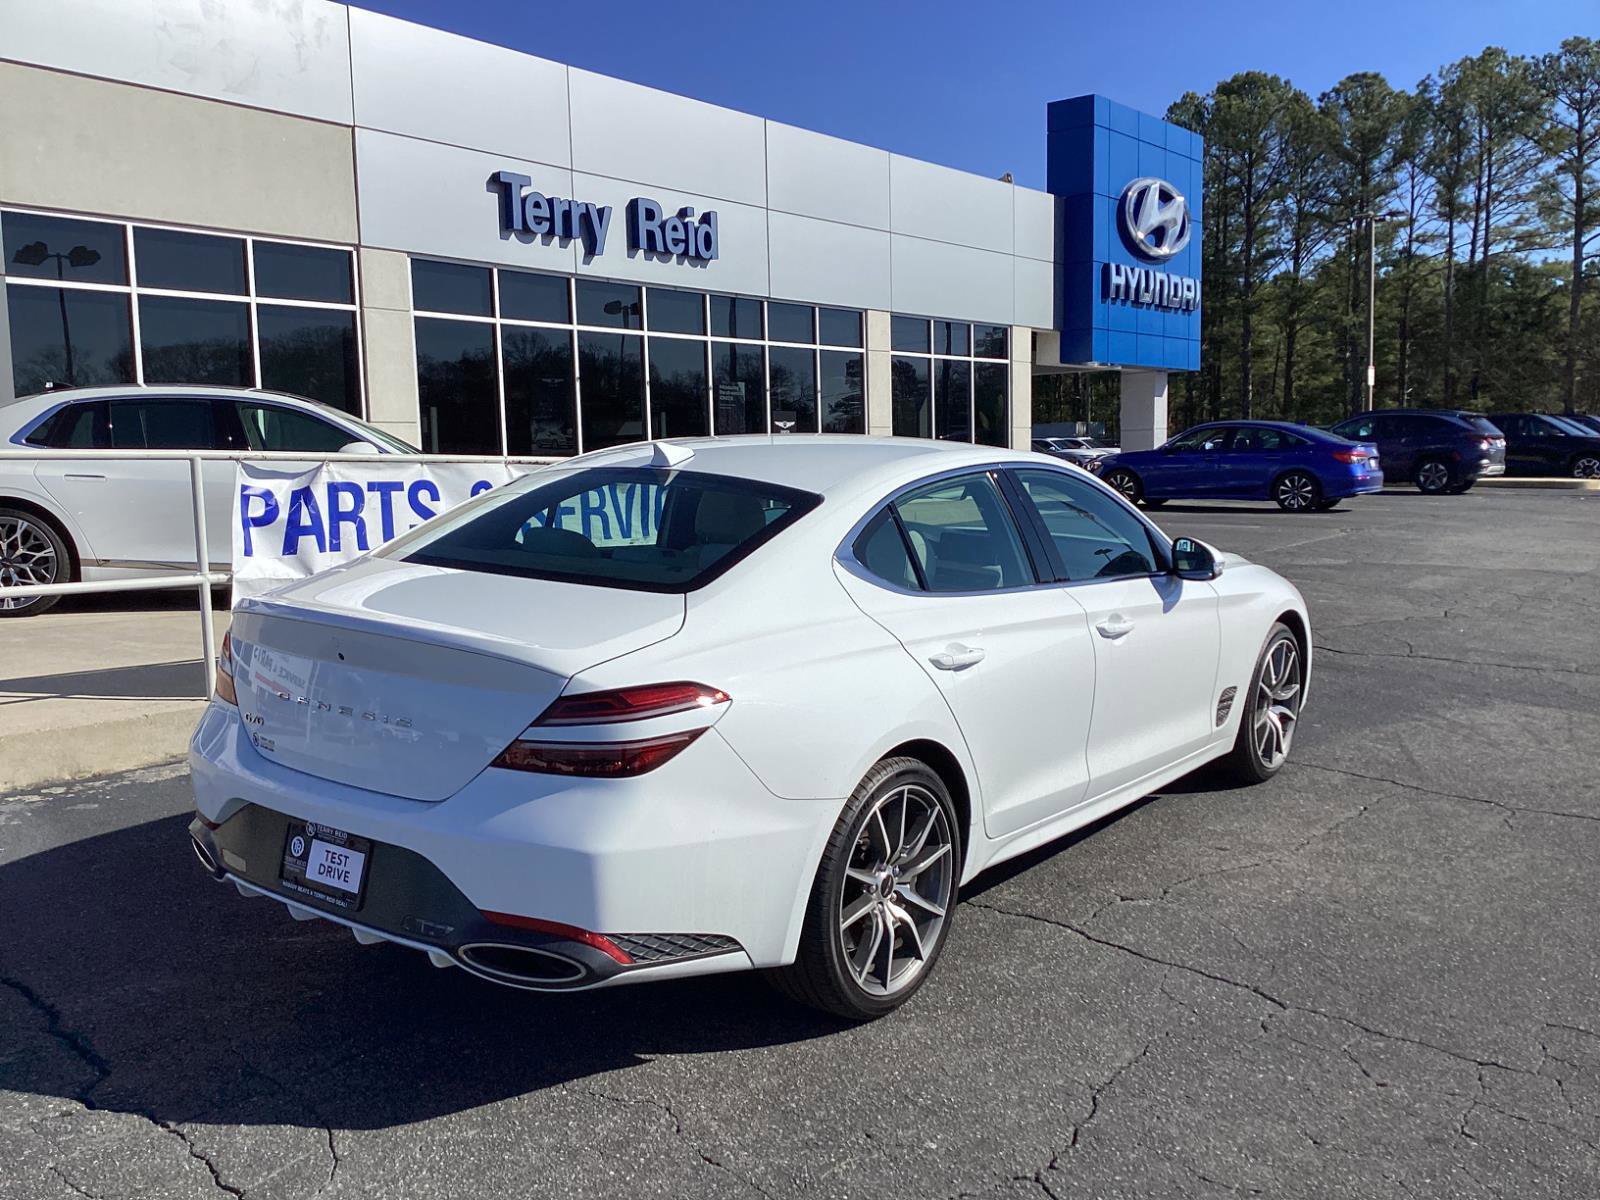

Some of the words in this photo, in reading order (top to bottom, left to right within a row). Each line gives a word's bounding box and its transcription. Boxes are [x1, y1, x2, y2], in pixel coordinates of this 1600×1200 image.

[490, 171, 612, 257] Terry
[628, 197, 719, 260] Reid
[1108, 262, 1200, 311] HYUNDAI
[240, 479, 440, 556] PARTS
[277, 691, 413, 728] GENESIS
[318, 863, 350, 883] DRIVE
[325, 849, 350, 867] TEST
